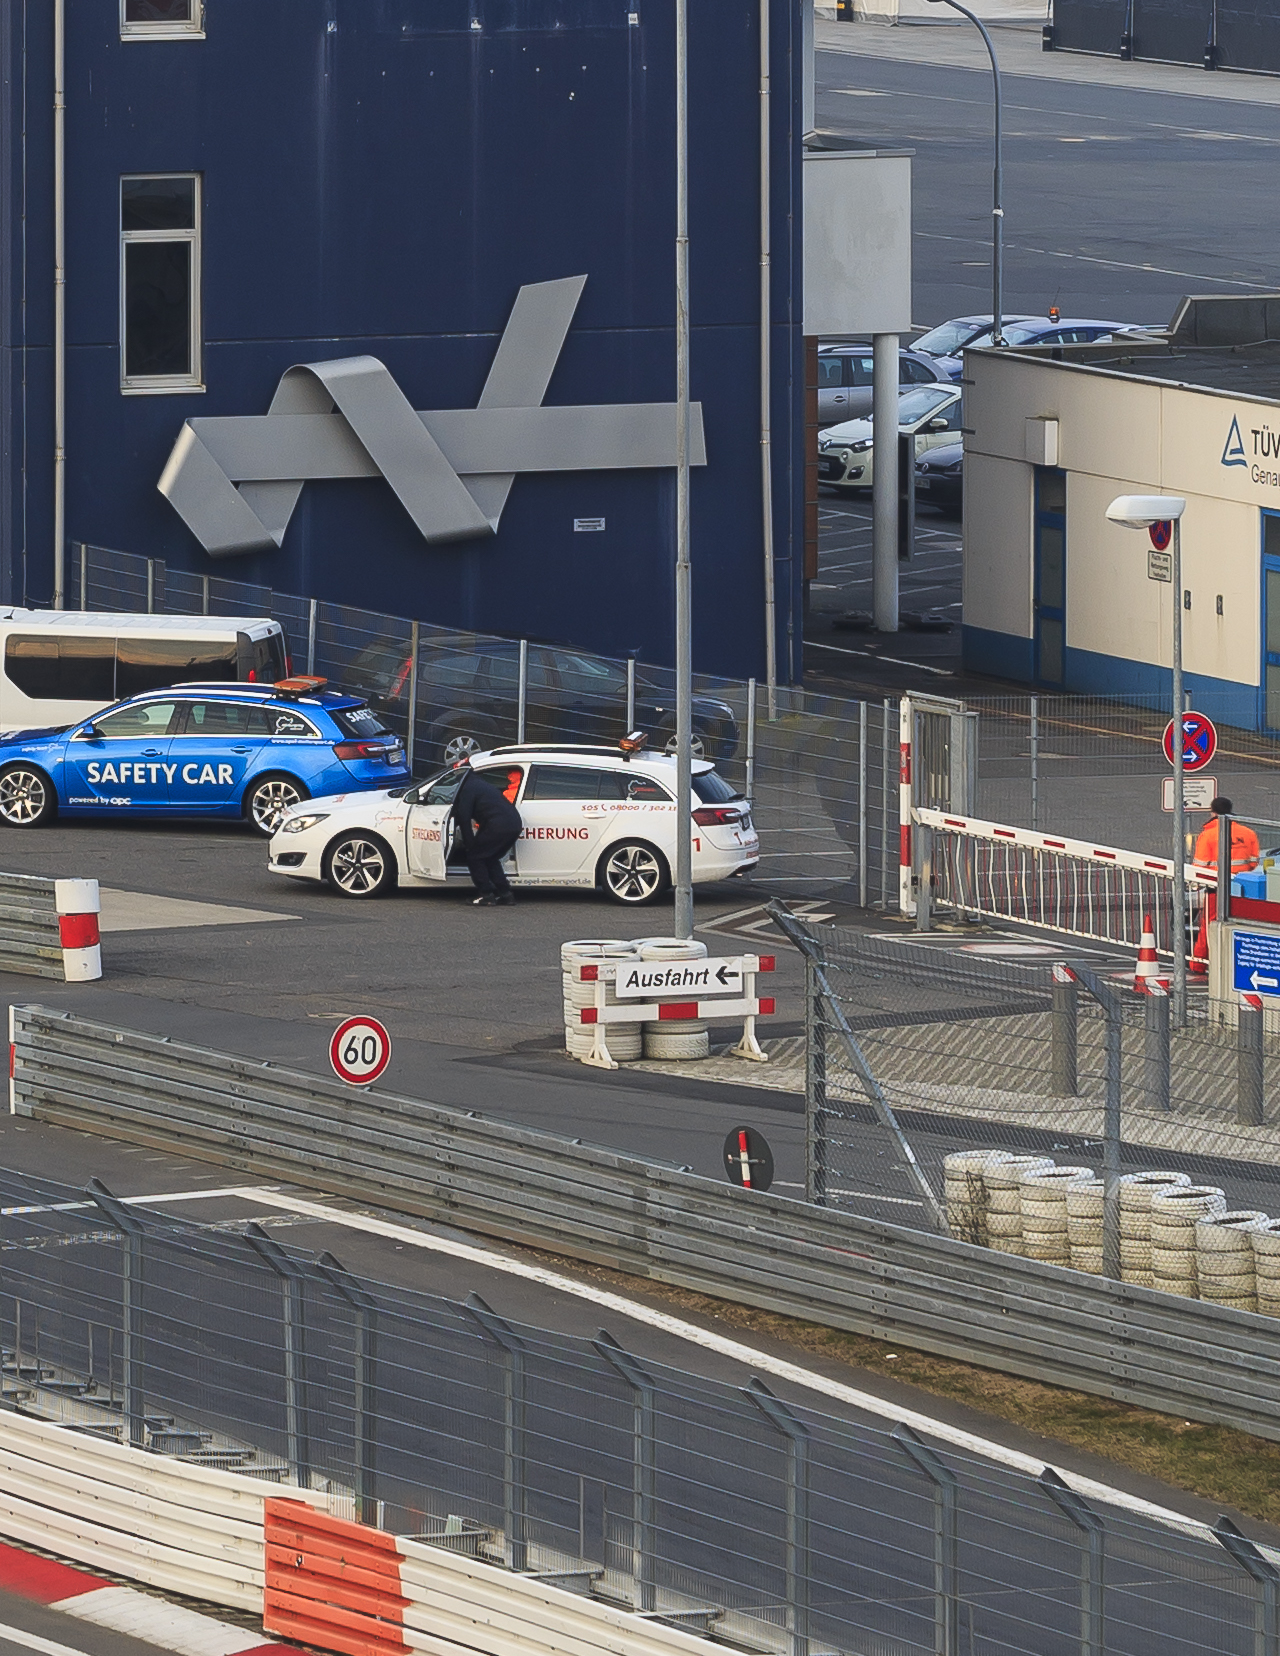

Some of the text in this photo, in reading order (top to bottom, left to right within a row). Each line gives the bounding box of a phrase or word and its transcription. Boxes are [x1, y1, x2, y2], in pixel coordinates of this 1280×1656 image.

[1251, 425, 1280, 459] TÜV
[87, 762, 233, 785] SAFETY CAR
[100, 796, 109, 805] by
[626, 968, 709, 988] Ausfahrt
[343, 1034, 378, 1067] 60
